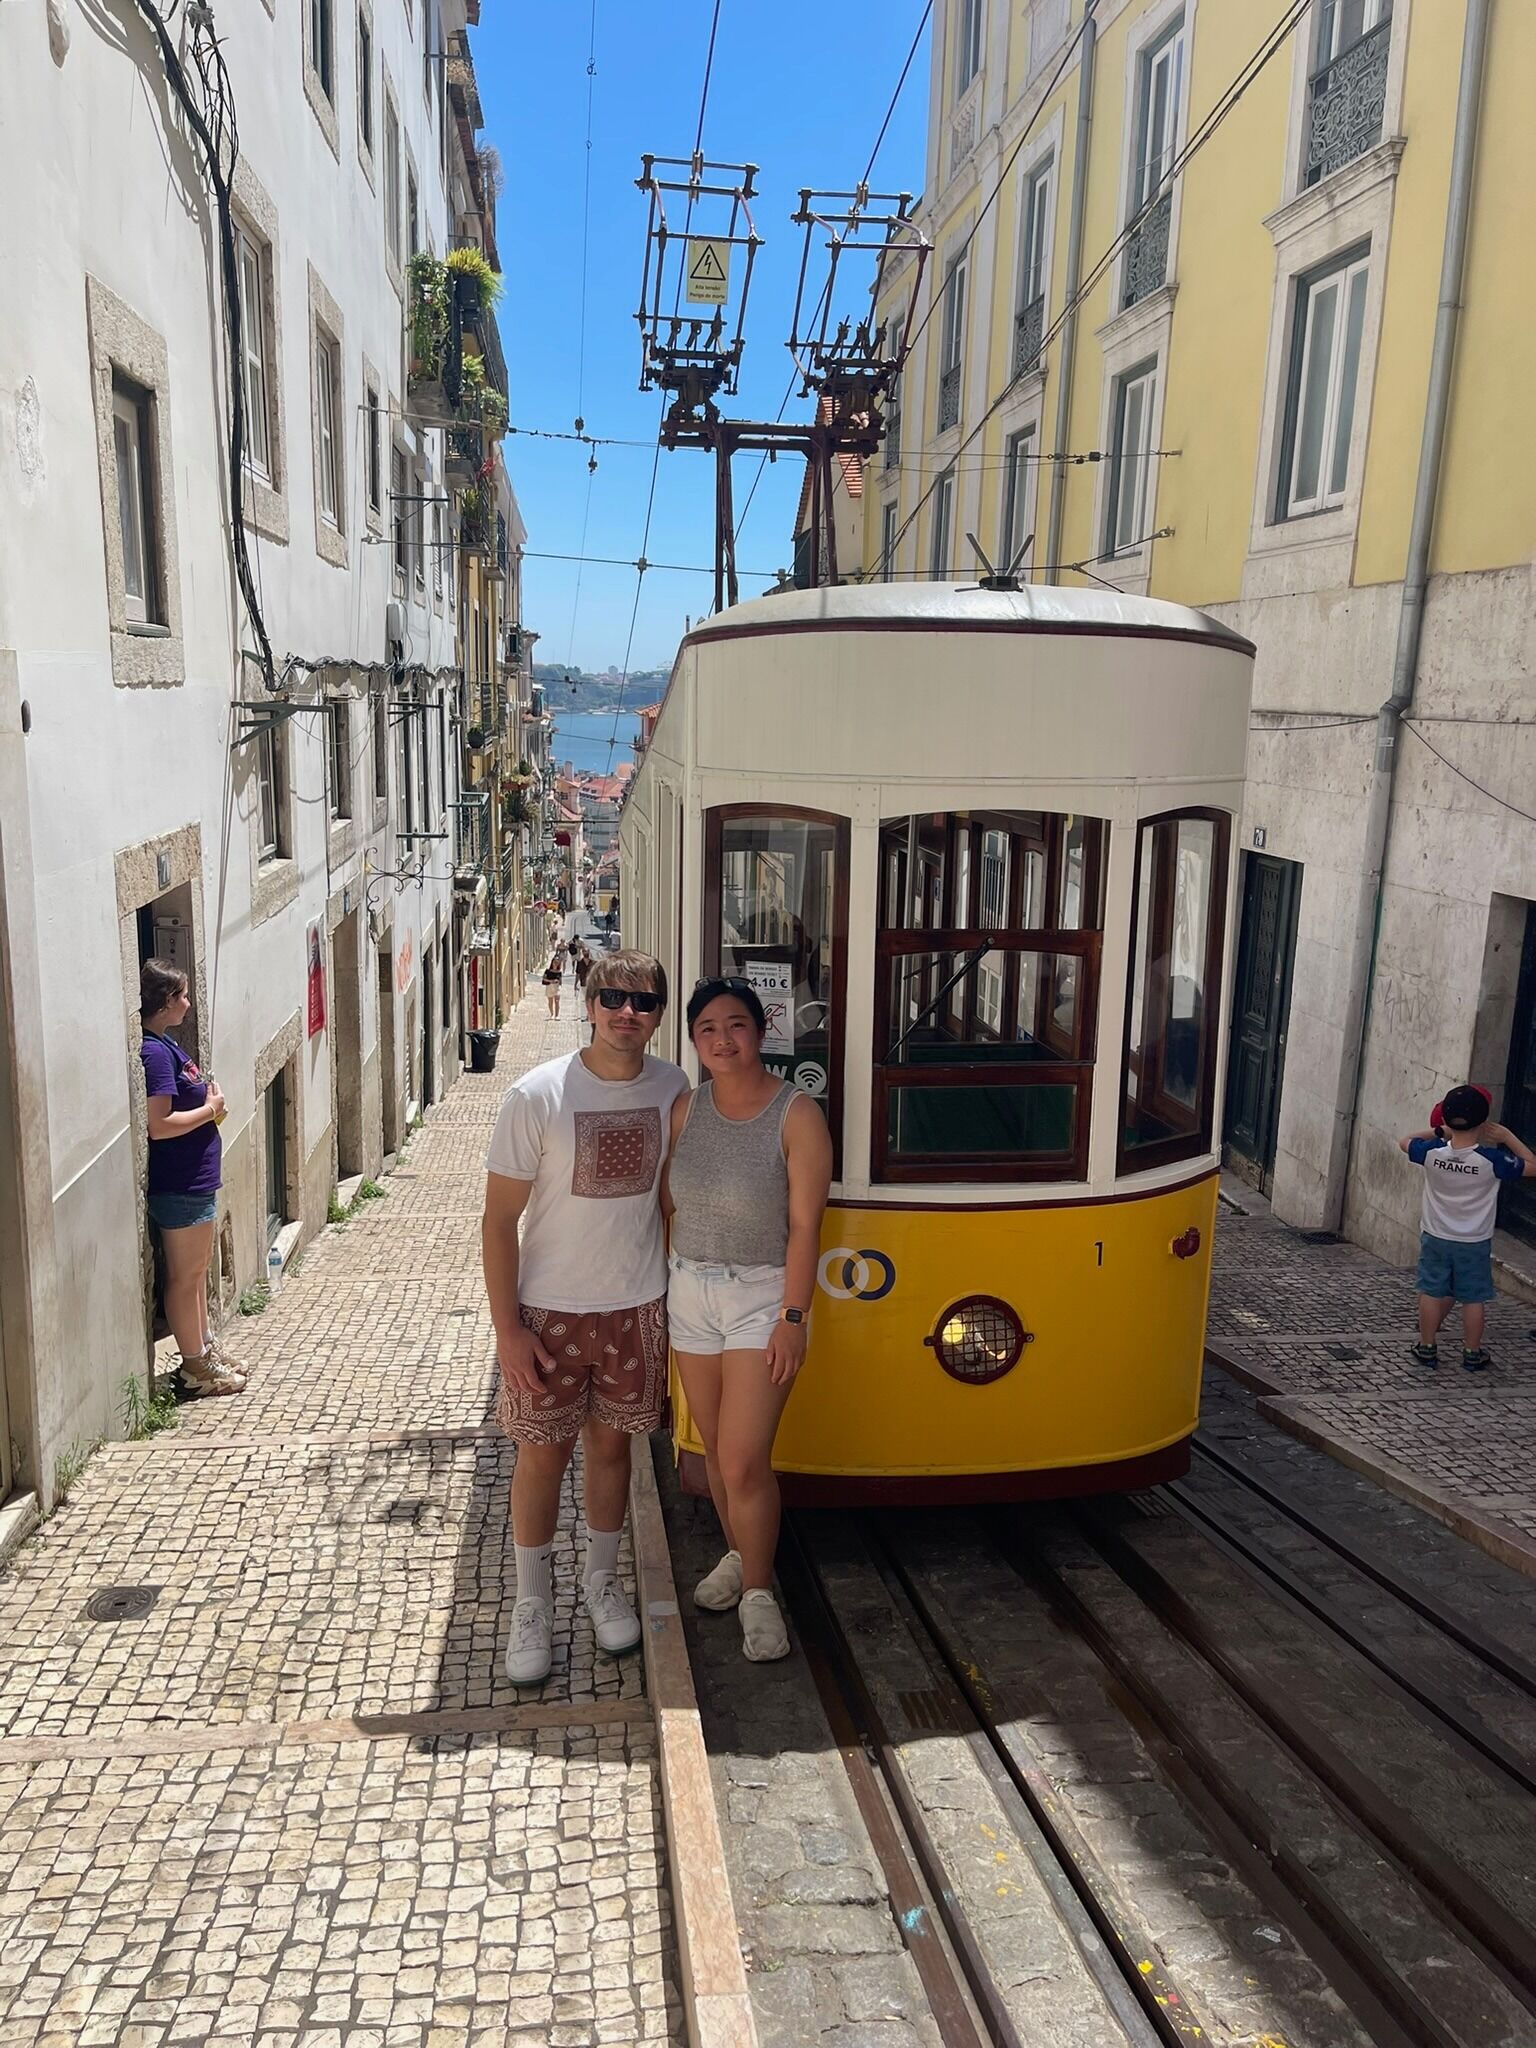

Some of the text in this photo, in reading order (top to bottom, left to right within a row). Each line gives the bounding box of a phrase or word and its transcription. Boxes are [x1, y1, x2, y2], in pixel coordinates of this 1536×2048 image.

[751, 977, 788, 988] 4.10 €
[1433, 1158, 1479, 1176] FRANCE
[1094, 1240, 1103, 1267] 1
